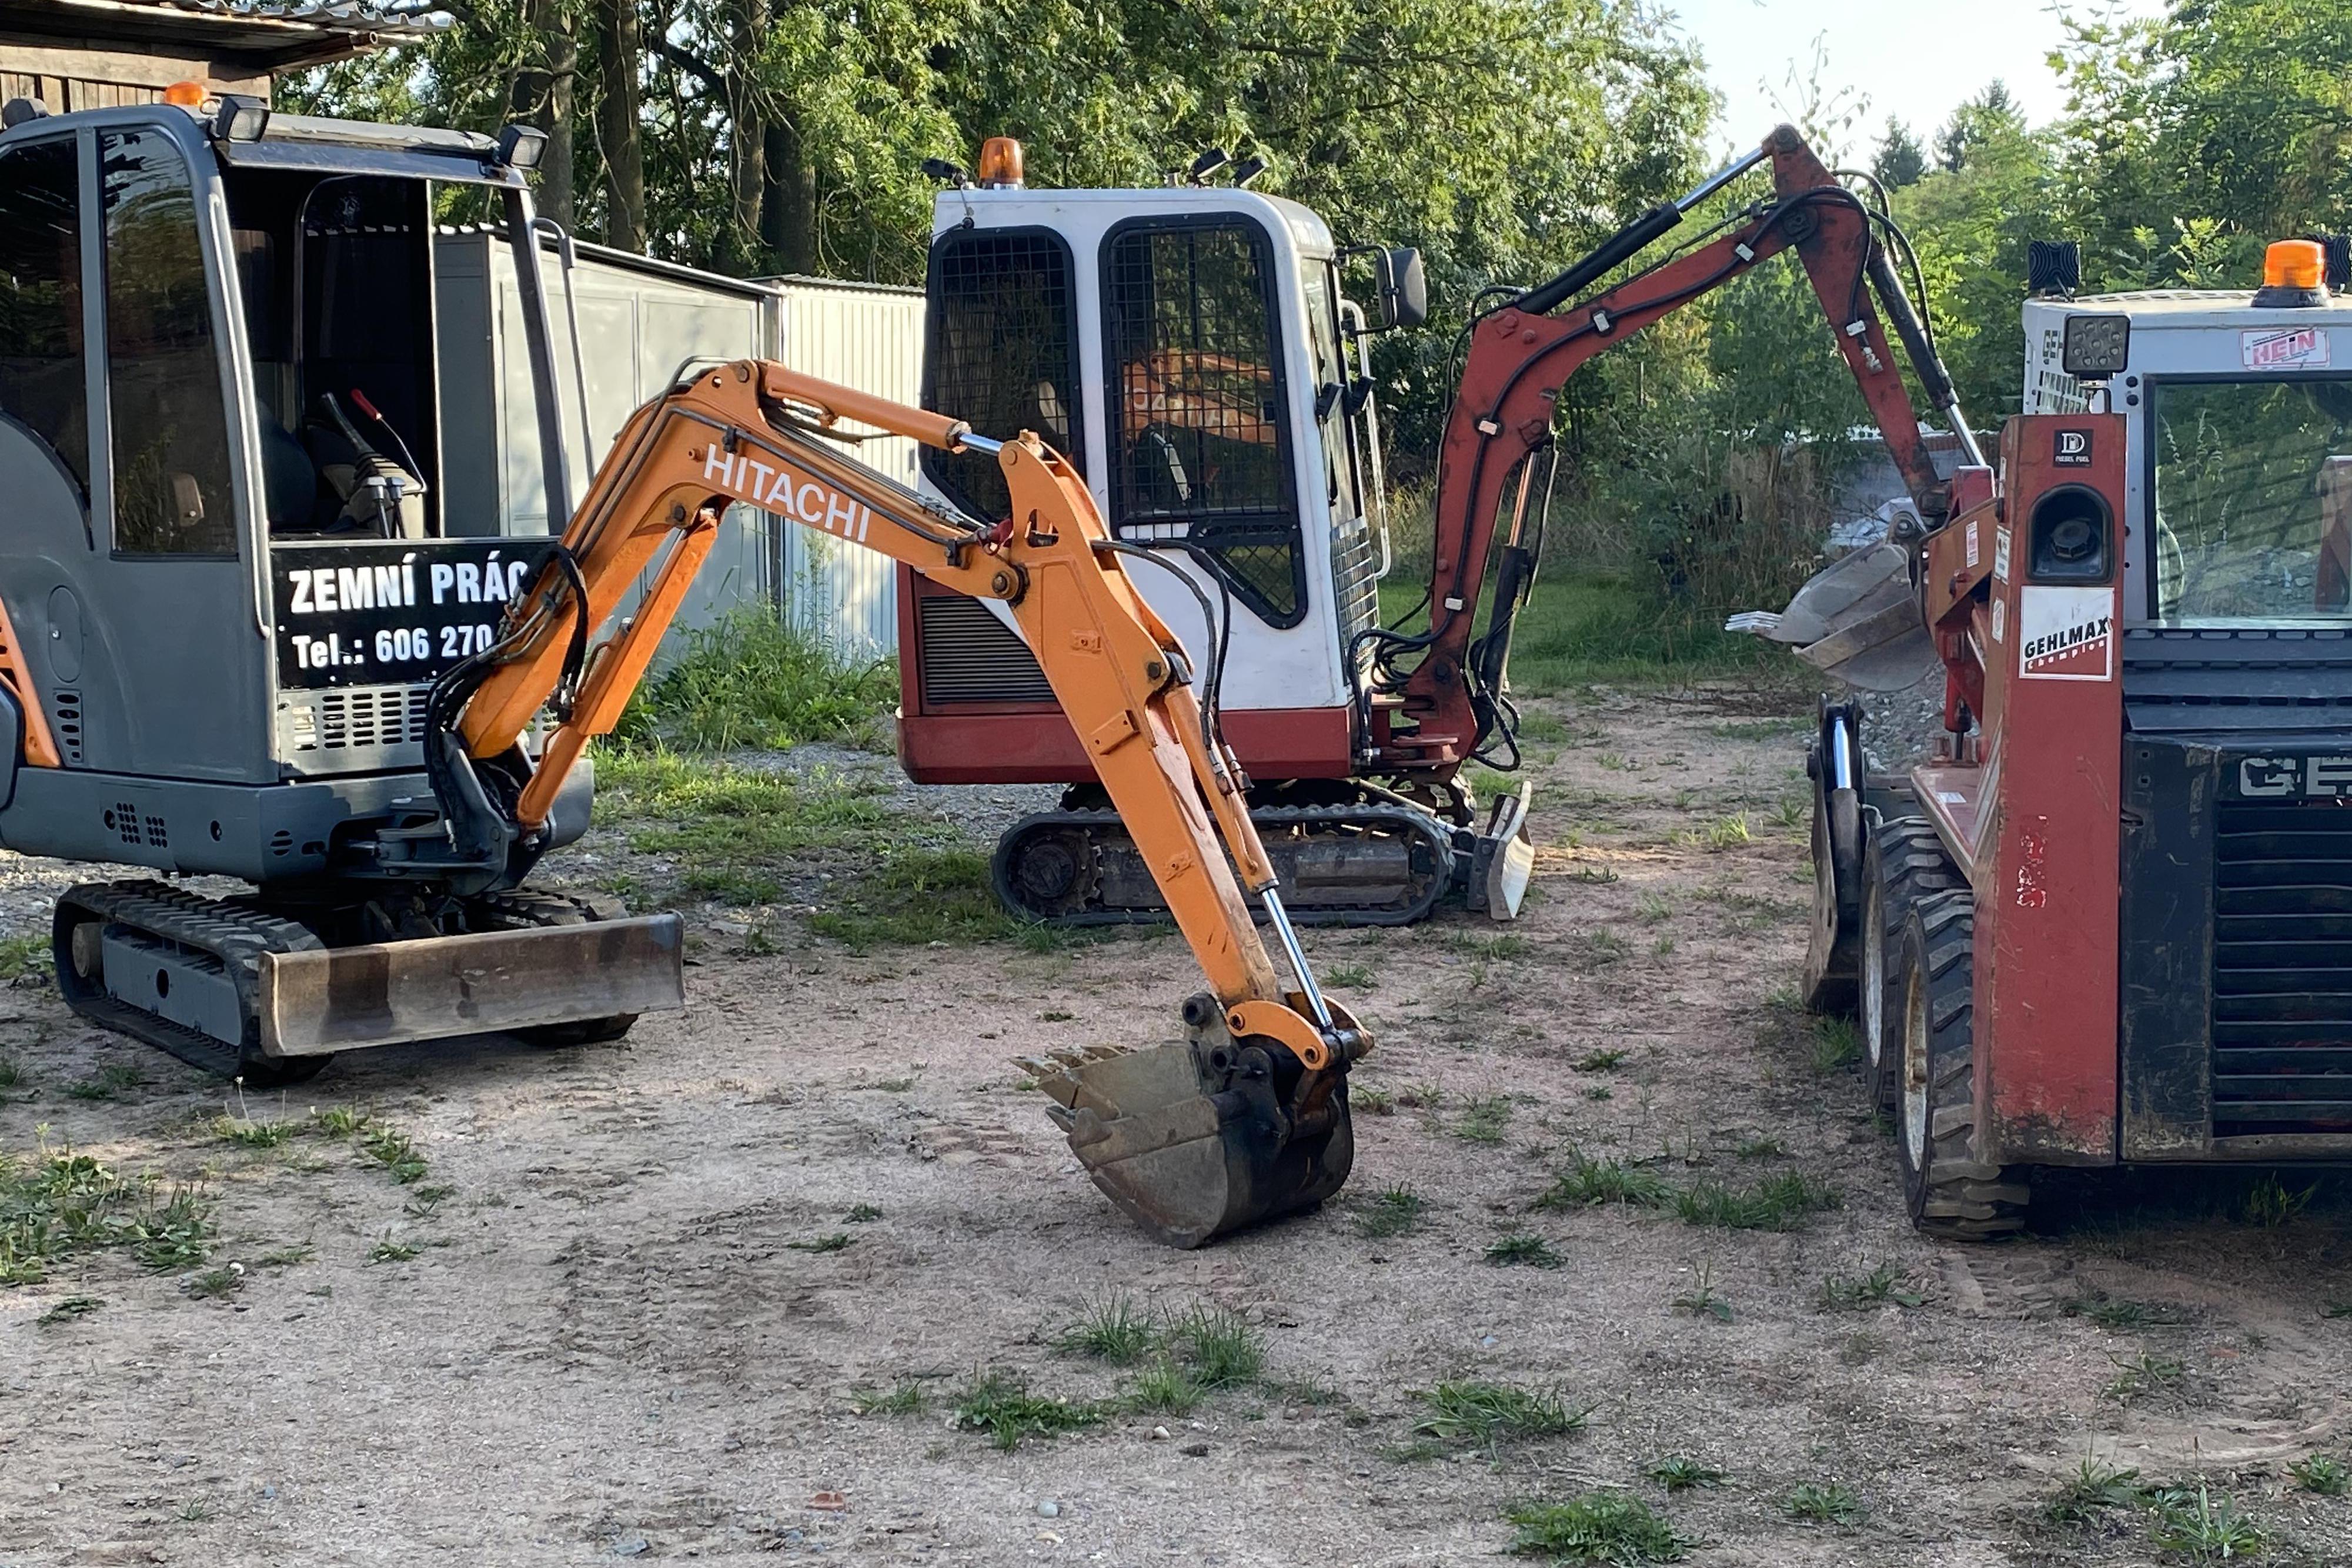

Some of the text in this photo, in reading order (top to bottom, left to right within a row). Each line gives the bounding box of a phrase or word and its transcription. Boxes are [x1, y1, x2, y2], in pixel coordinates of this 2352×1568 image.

[704, 443, 870, 542] HITACHI
[289, 553, 416, 613] ZEMNÍ
[292, 624, 492, 668] Tel.: 606 270
[2025, 616, 2108, 658] GEHLMAX
